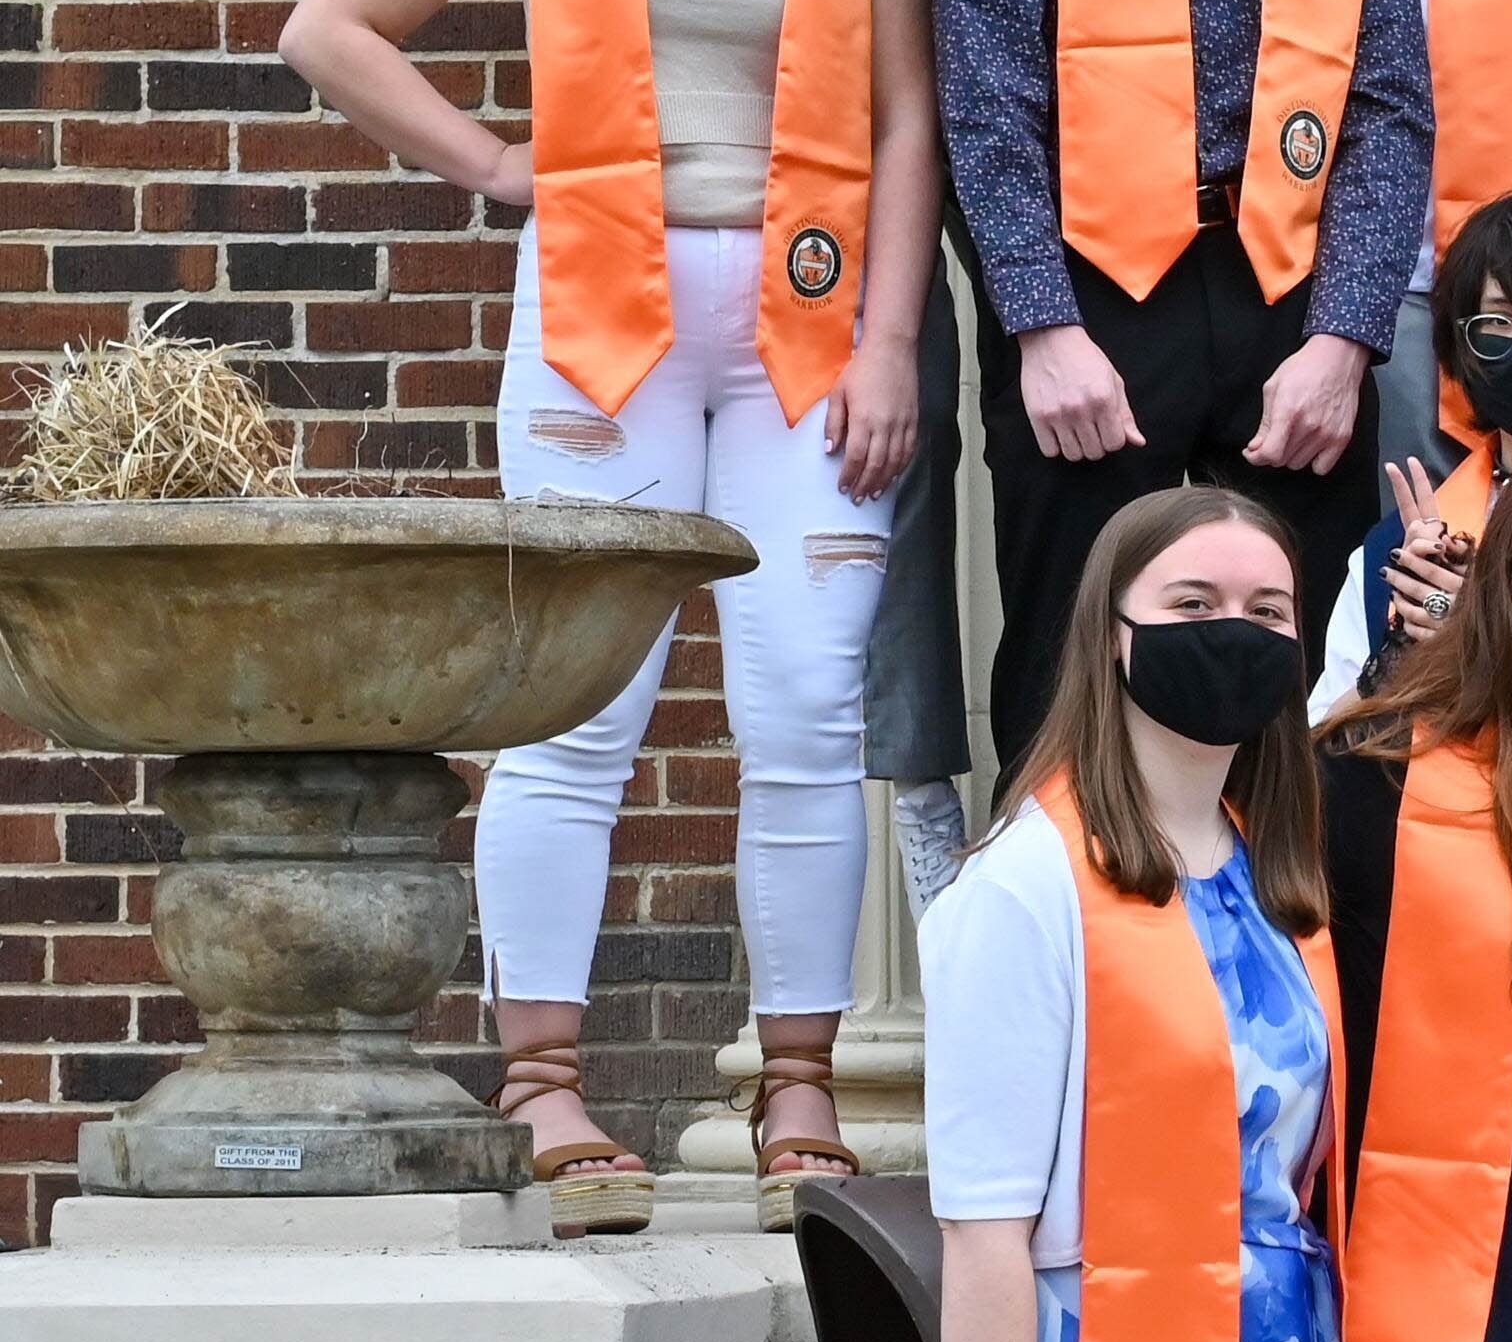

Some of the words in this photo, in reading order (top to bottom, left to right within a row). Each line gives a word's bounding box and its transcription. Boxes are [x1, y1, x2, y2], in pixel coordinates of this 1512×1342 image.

[789, 292, 833, 310] WARRIOR
[245, 1148, 275, 1156] FROM
[279, 1149, 298, 1157] THE
[220, 1157, 254, 1165] CLASS
